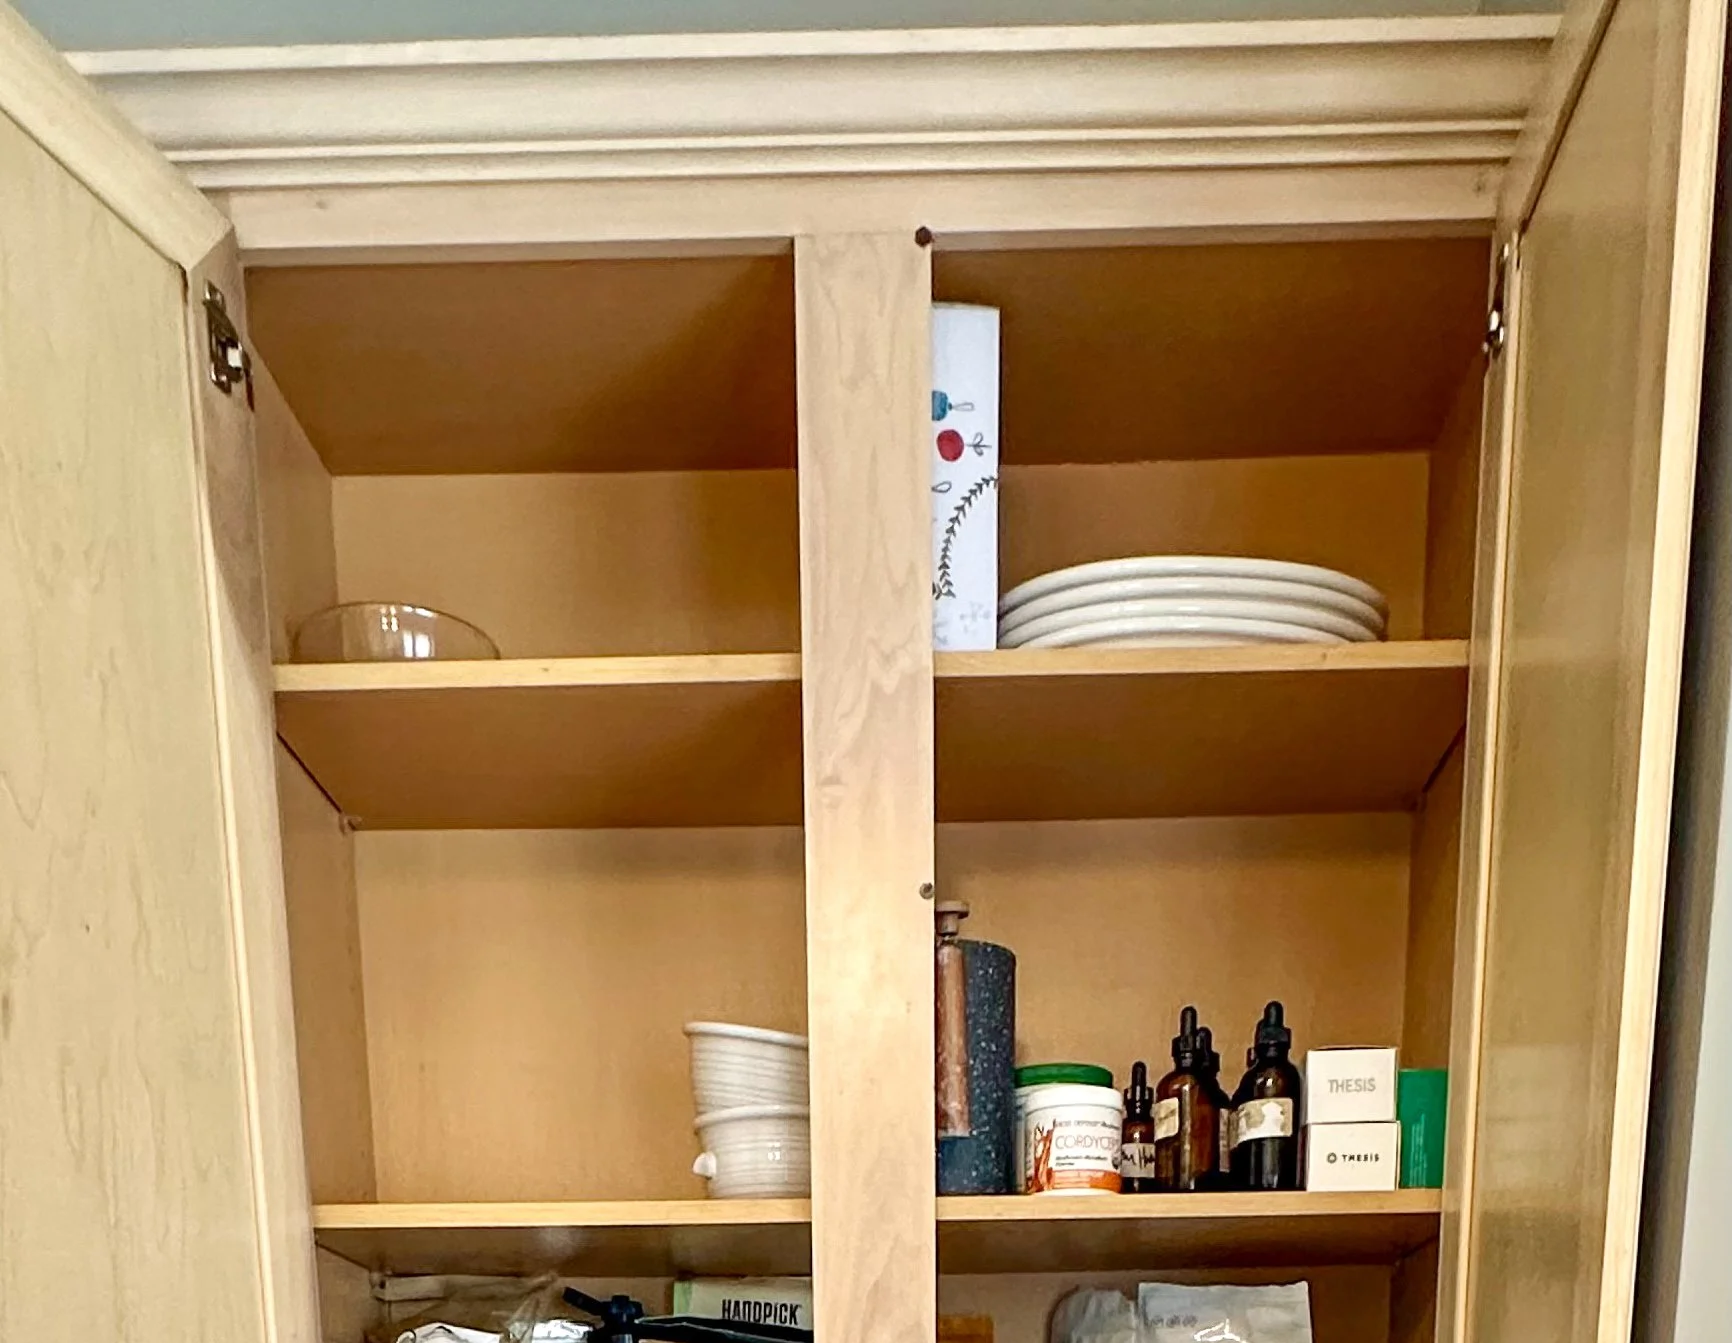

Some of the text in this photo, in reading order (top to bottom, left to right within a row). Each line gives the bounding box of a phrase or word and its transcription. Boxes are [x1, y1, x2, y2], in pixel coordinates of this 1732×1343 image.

[1328, 1077, 1376, 1093] THESIS
[1341, 1153, 1379, 1162] THESIS
[721, 1298, 799, 1325] HANDPICK
